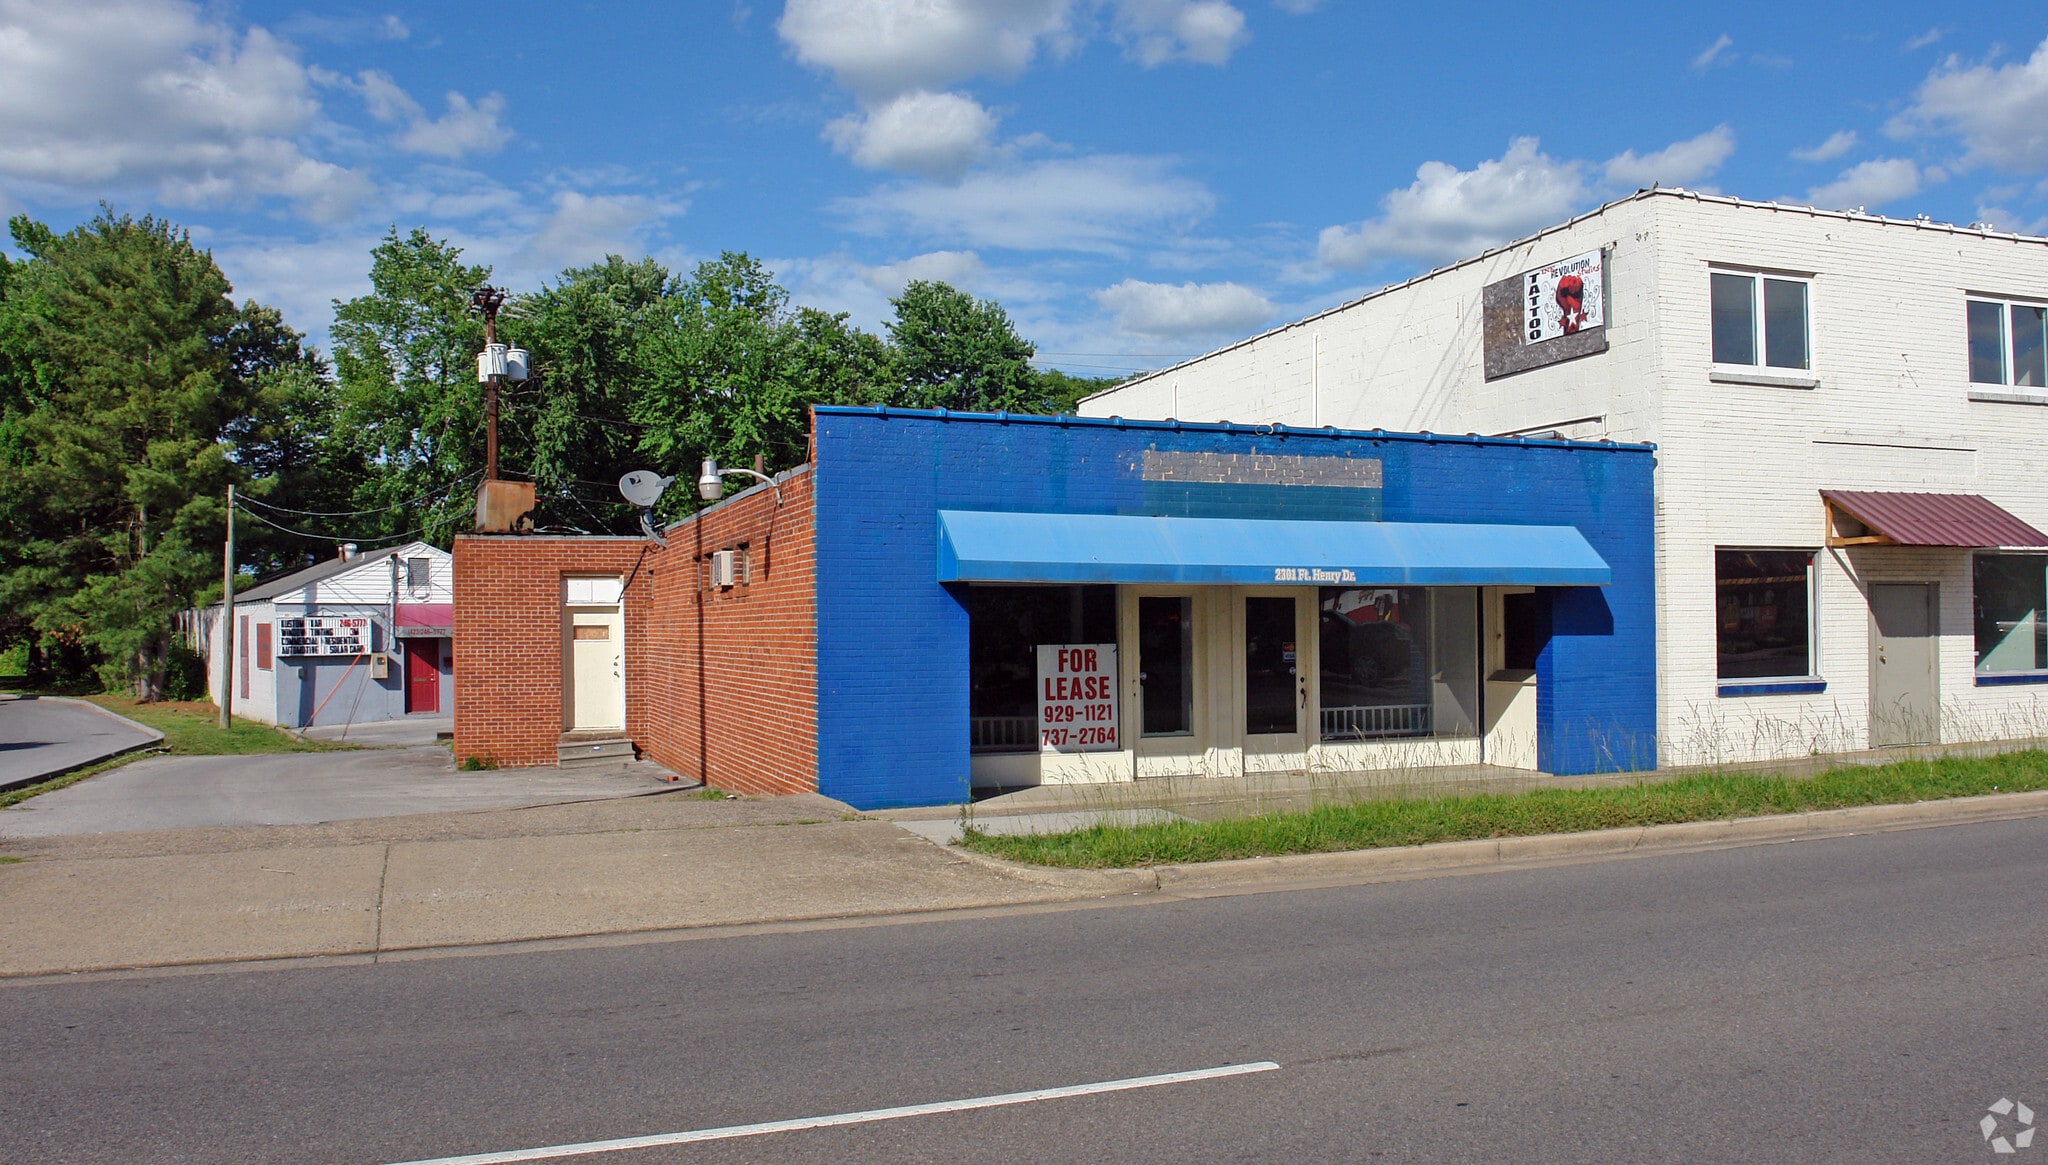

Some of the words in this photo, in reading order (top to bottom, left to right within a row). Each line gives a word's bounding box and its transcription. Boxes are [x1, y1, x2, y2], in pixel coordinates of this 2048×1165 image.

[1550, 258, 1590, 279] REVOLUTION
[1528, 272, 1542, 340] TATTOO
[1274, 567, 1297, 581] 2301
[1297, 567, 1311, 581] Ft.
[1312, 567, 1341, 584] Henry
[1341, 568, 1357, 582] Dr.
[281, 637, 319, 645] COMMERCIAL
[324, 636, 360, 645] RESIDENTIAL
[310, 628, 334, 636] TINTING
[281, 645, 319, 655] AUTOMOTIVE
[329, 645, 348, 654] SOLAR
[1058, 648, 1097, 673] FOR
[1045, 676, 1111, 701] LEASE
[1044, 704, 1112, 723] 929-1121
[1041, 726, 1116, 746] 737-2764
